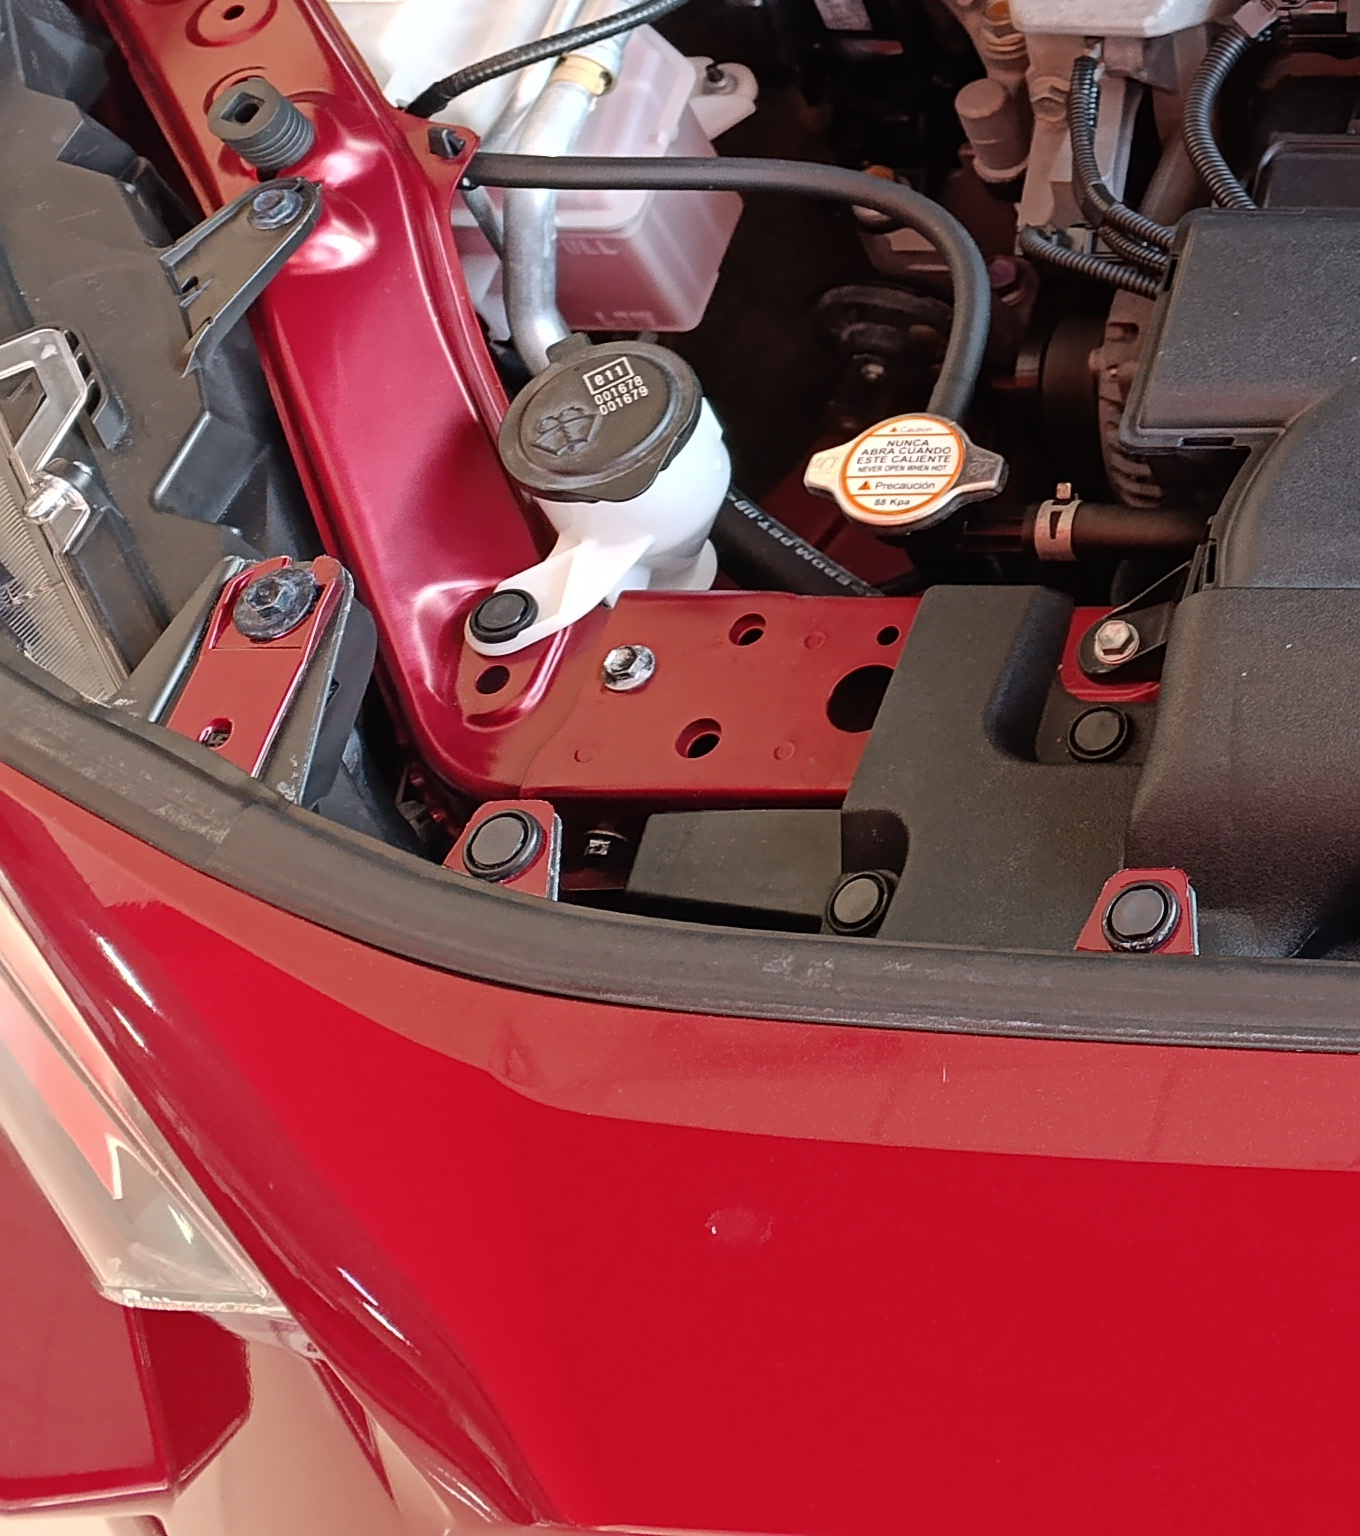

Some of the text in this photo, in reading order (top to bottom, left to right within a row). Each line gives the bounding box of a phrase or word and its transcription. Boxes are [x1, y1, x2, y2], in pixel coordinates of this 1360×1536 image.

[593, 365, 625, 386] e11
[594, 375, 644, 405] 001678
[599, 385, 649, 415] 001679
[886, 439, 930, 447] NUNCA
[861, 446, 952, 456] ABRA CUANDO
[890, 455, 952, 464] CALIENTE
[857, 465, 884, 473] NEVER
[906, 464, 930, 472] WHEN
[931, 464, 948, 472] HOT
[874, 480, 936, 490] Precaución
[889, 498, 910, 507] Kpa
